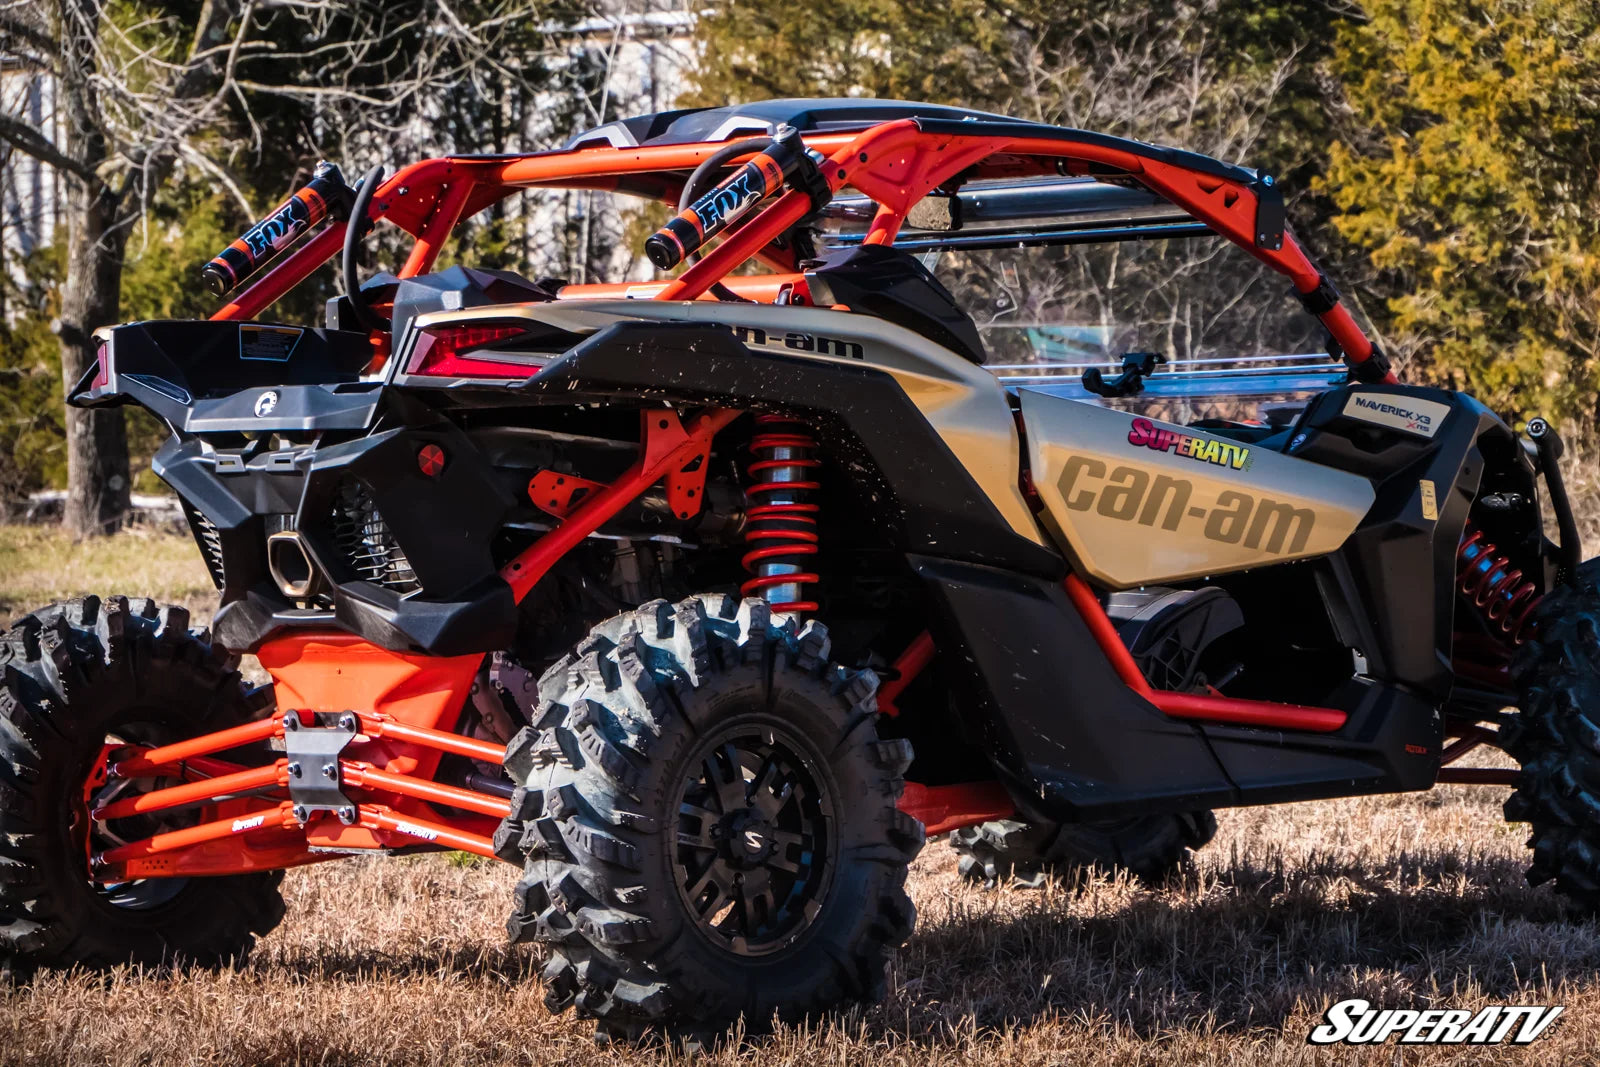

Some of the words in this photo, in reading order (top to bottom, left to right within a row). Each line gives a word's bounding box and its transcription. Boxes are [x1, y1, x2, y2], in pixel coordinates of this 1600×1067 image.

[244, 204, 297, 259] FOX
[696, 173, 753, 234] FOX
[1356, 397, 1414, 420] MAVERICK
[1415, 413, 1431, 425] X3
[1057, 455, 1316, 555] can-am
